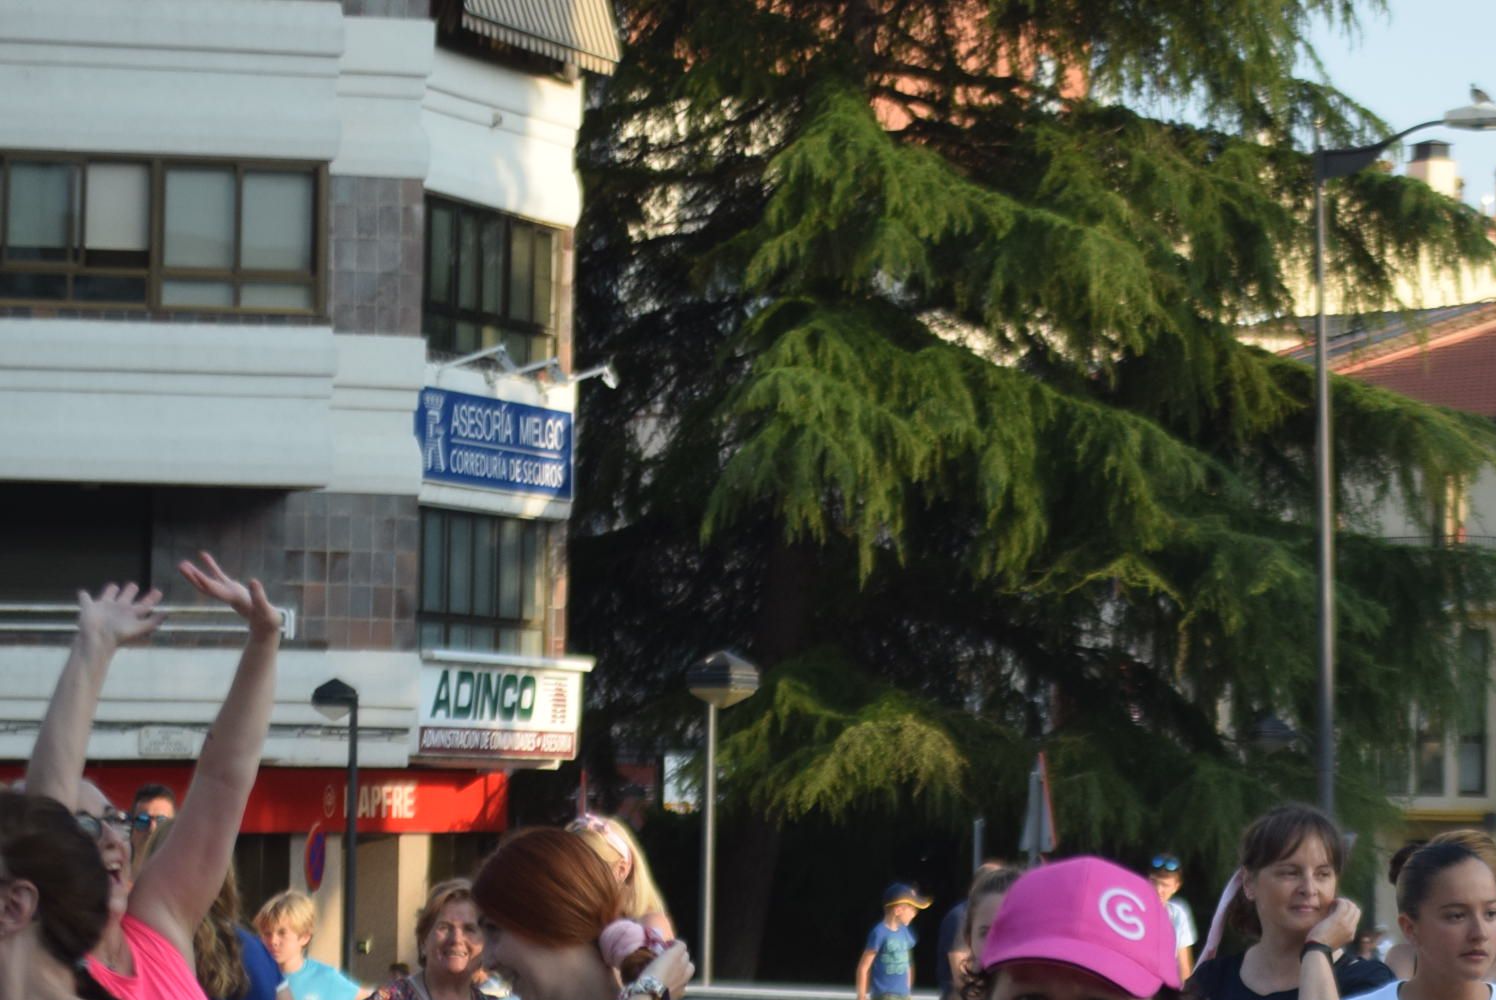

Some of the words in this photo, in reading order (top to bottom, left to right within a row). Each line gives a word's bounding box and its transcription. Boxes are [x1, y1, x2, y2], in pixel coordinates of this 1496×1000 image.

[451, 402, 513, 444] ASESORÍA
[509, 459, 522, 482] DE
[523, 461, 563, 488] SEGUROS
[430, 669, 536, 721] ADINCO
